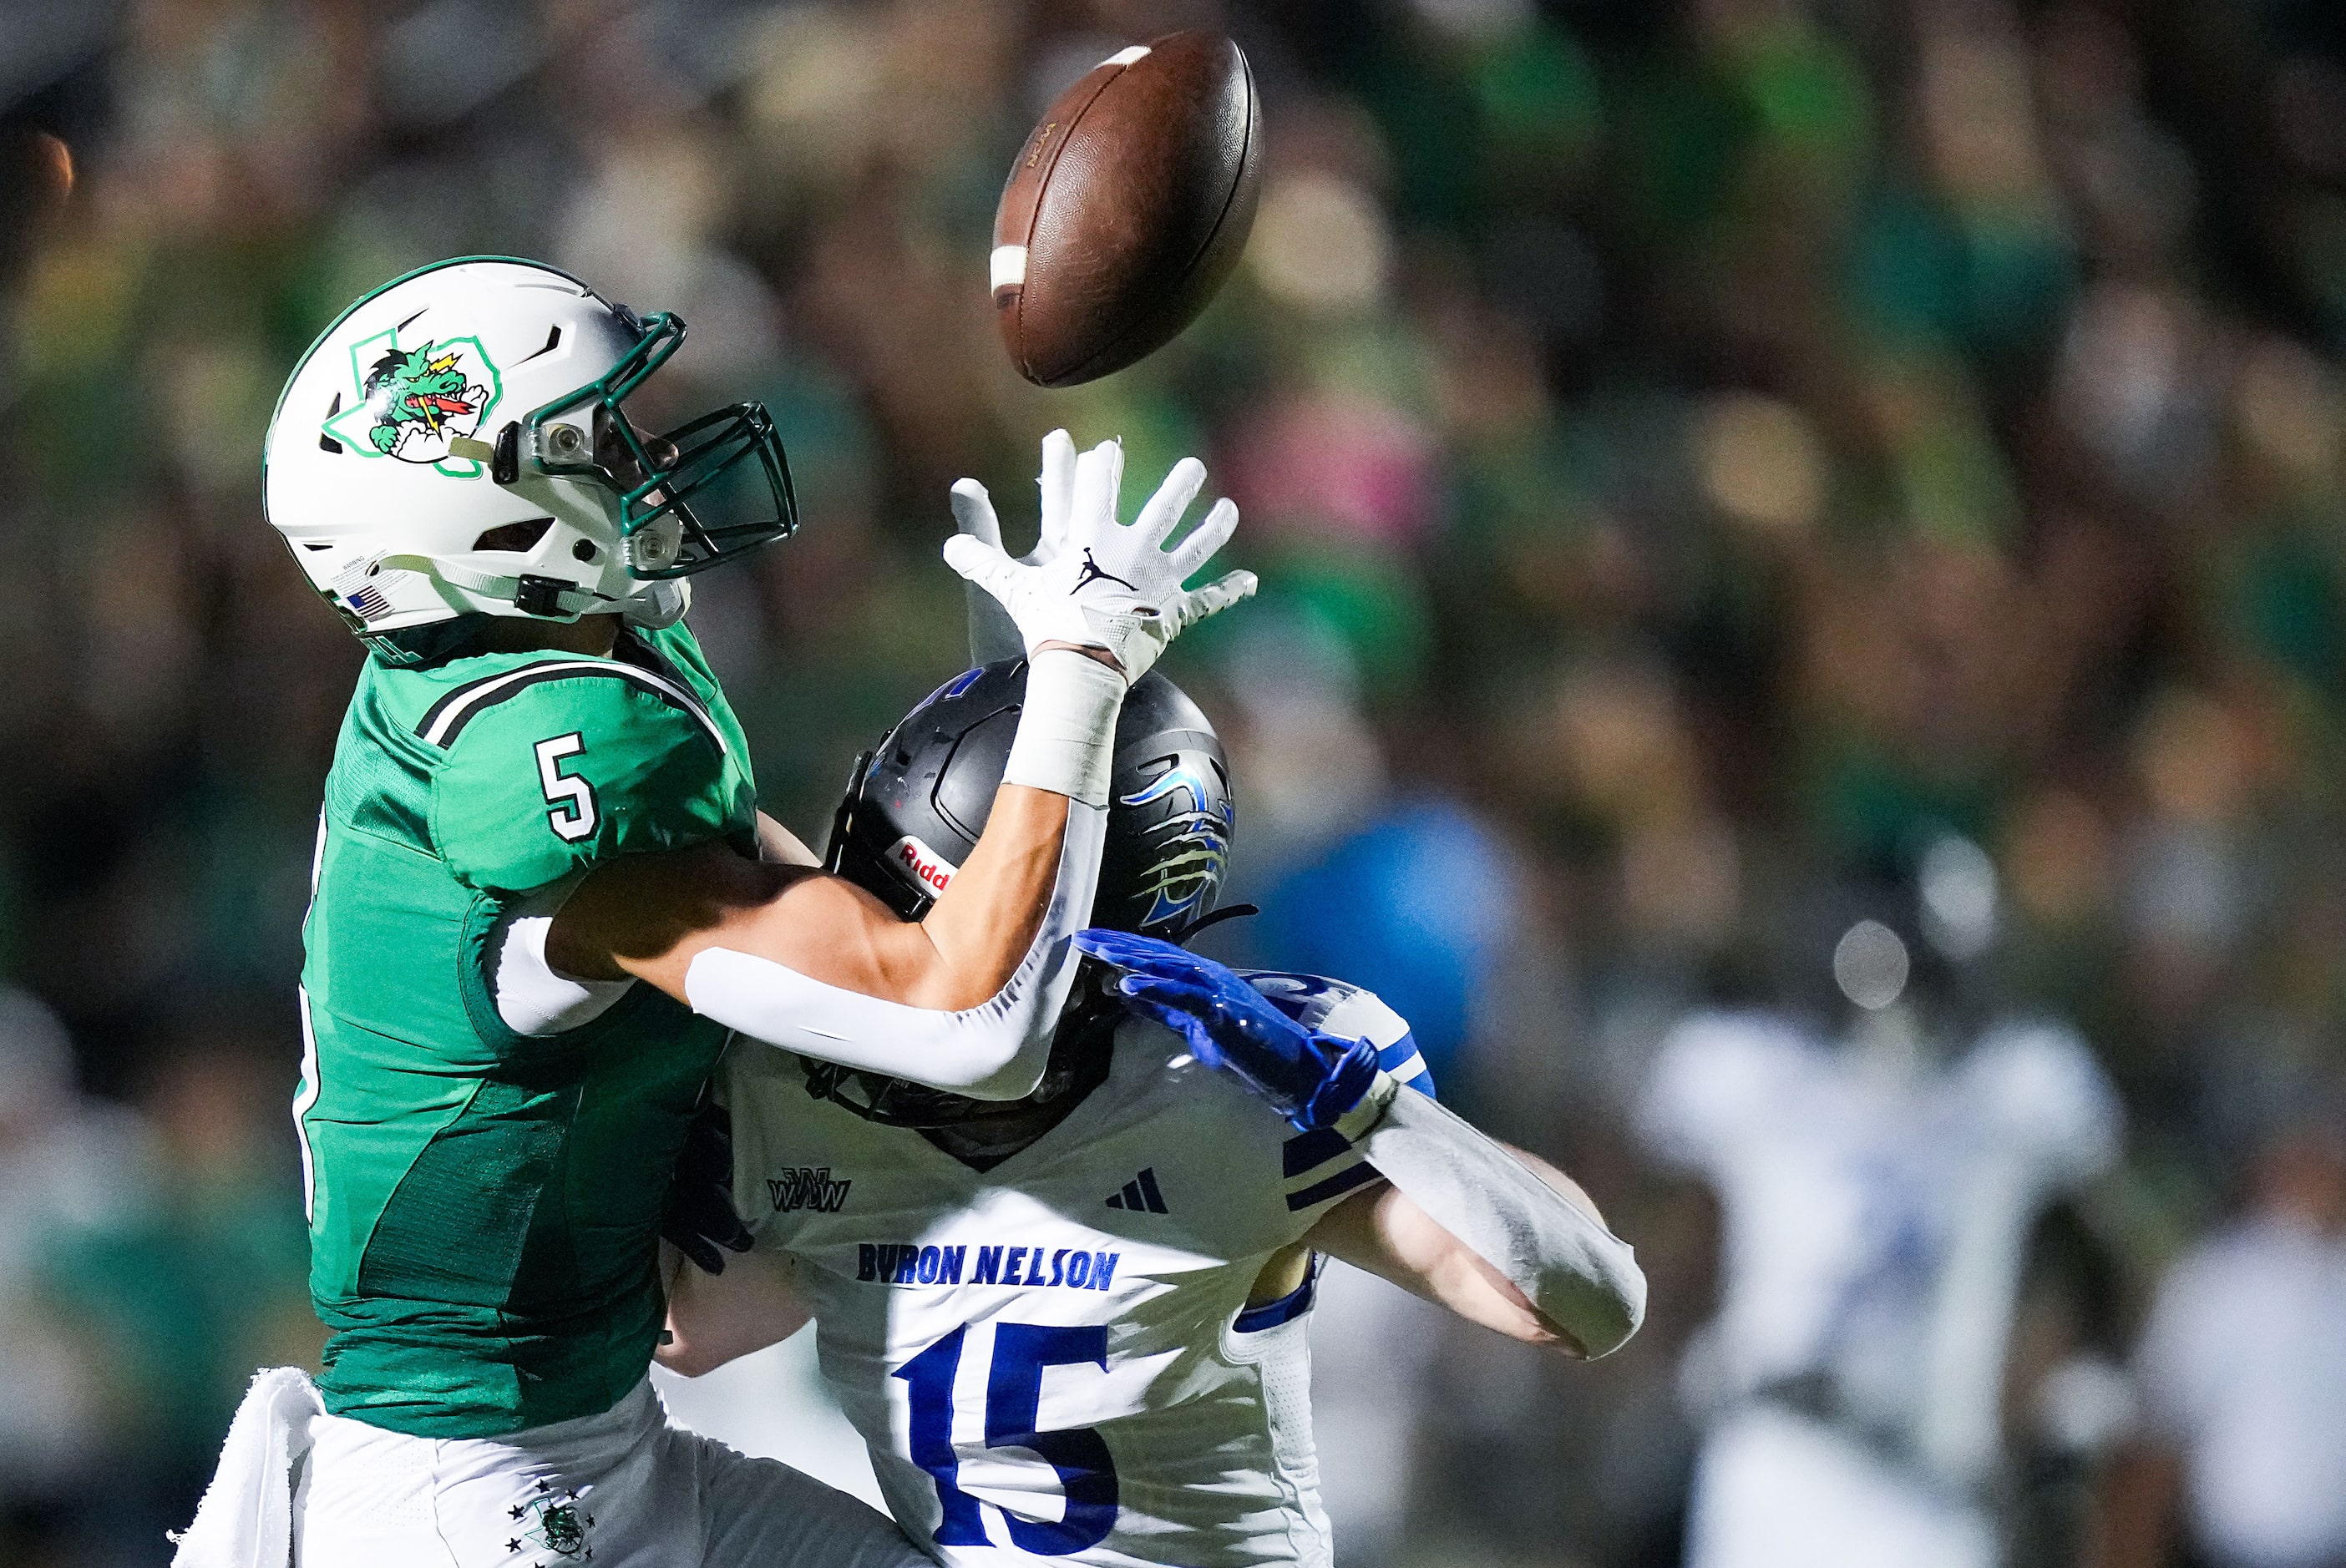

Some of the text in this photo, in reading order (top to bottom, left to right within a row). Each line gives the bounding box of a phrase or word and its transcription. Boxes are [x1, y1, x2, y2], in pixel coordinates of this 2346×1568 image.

[342, 555, 365, 571] WARNING
[533, 731, 602, 845] 5
[899, 842, 950, 892] Ridd
[856, 1243, 1121, 1292] BYRON NELSON
[891, 1321, 1119, 1557] 15
